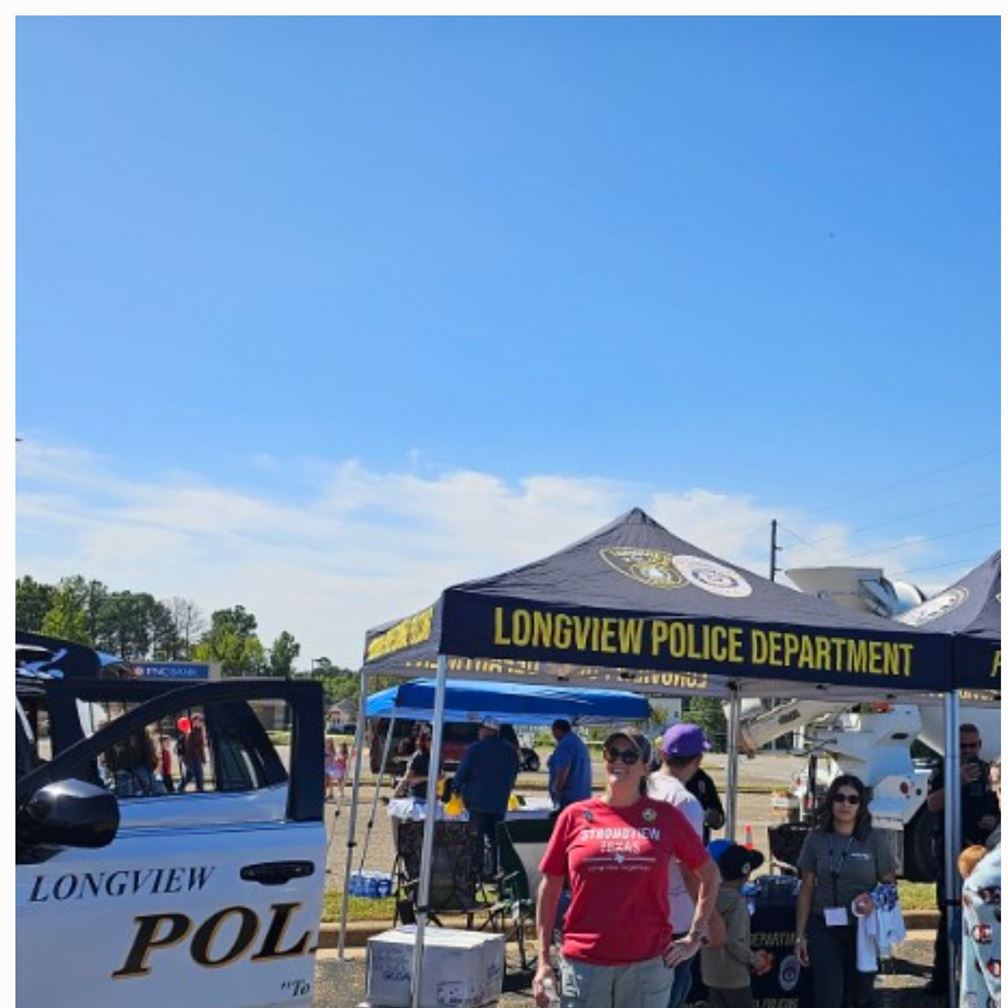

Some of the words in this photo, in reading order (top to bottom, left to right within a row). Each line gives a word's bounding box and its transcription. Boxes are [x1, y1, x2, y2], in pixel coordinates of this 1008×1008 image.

[494, 607, 643, 656] LONGVIEW
[651, 620, 743, 663] POLICE
[751, 629, 913, 677] DEPARTMENT
[30, 866, 216, 902] LONGVIEW
[109, 902, 319, 981] POL
